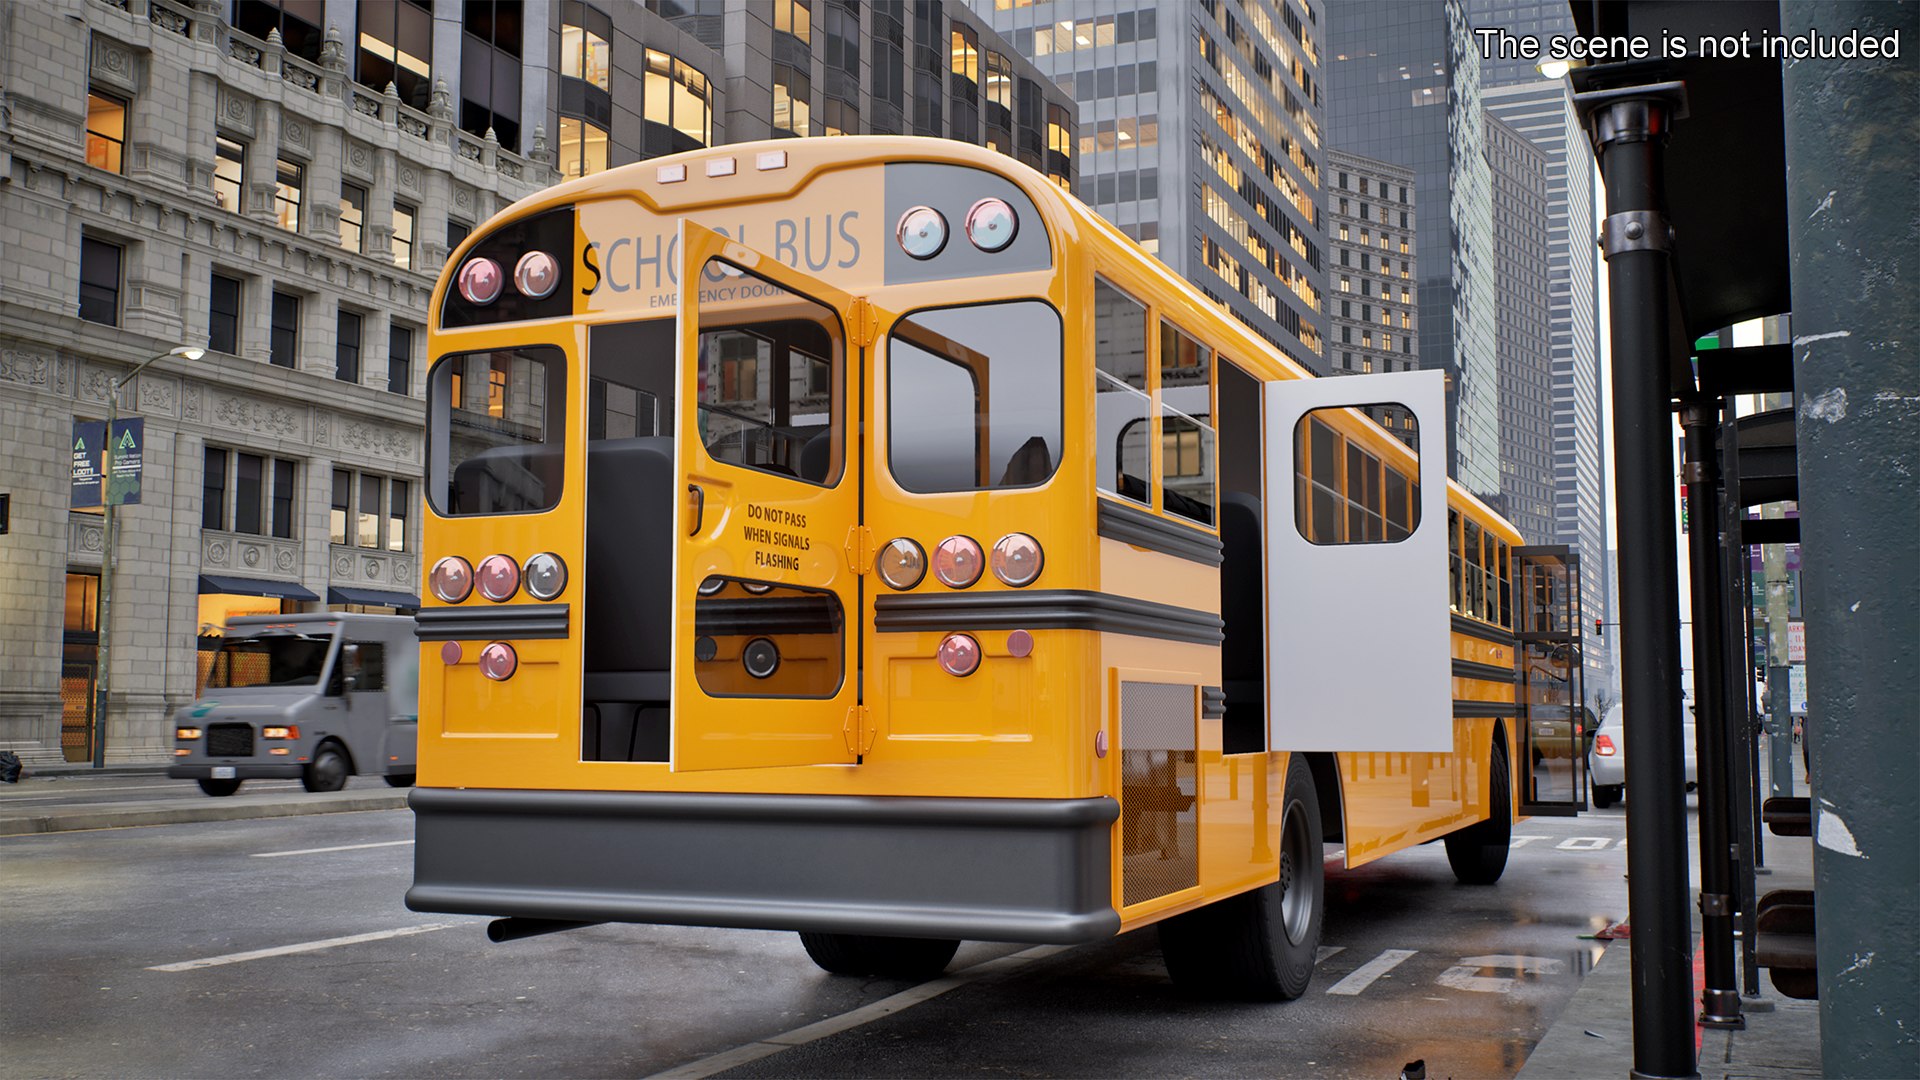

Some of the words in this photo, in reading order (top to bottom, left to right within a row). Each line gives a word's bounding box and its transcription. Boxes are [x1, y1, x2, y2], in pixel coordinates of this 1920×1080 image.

[775, 211, 860, 272] BUS
[650, 287, 737, 308] EMEENCY
[74, 452, 87, 460] GET
[74, 460, 90, 468] FREE
[748, 504, 762, 519] DO
[764, 507, 783, 524] NOT
[785, 511, 806, 529] PASS
[743, 526, 772, 544] WHEN
[773, 532, 810, 551] SIGNALS
[755, 551, 799, 571] FLASHING
